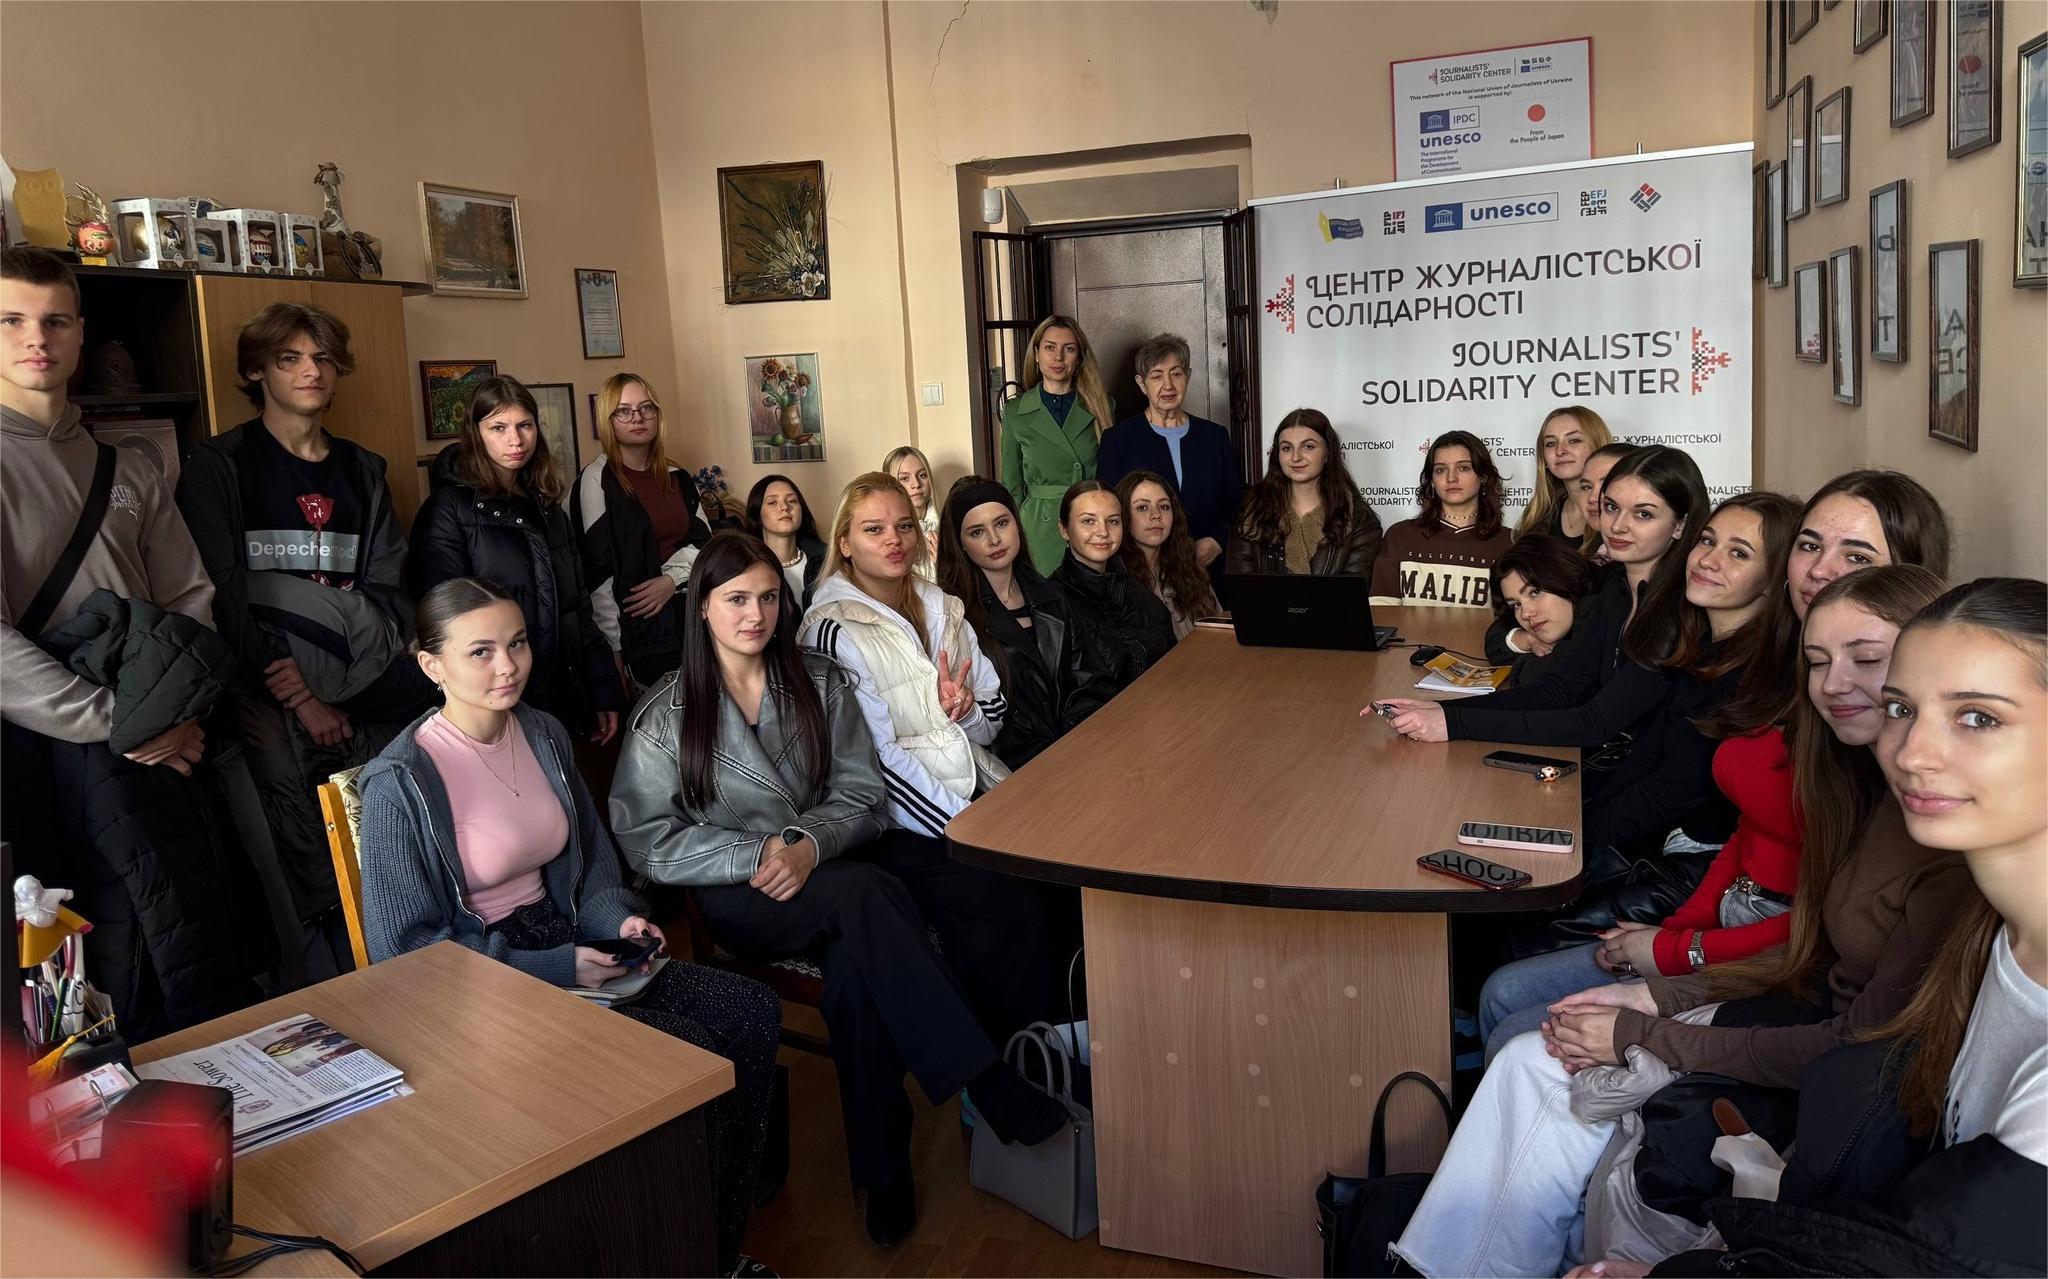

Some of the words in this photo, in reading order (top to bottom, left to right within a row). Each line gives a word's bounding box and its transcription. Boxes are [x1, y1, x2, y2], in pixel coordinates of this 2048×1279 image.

[1440, 63, 1490, 75] JOURNALISTS'
[1440, 72, 1481, 83] SOLIDARITY
[1483, 68, 1511, 78] CENTER
[1511, 81, 1542, 89] Journalists
[1474, 91, 1502, 99] supported
[1453, 113, 1476, 125] IPDC
[1420, 132, 1482, 148] unesco
[1470, 200, 1552, 221] unesco
[1305, 267, 1405, 301] ЦЕНТР
[1416, 238, 1702, 290] ЖУРНАЛІСТСЬКОЇ
[1305, 290, 1523, 329] СОЛІДАРНОСТІ
[1451, 330, 1681, 368] JOURNALISTS'
[1361, 373, 1537, 406] SOLIDARITY
[1550, 367, 1681, 398] CENTER
[1496, 447, 1536, 457] CENTER
[193, 1058, 233, 1086] Sower
